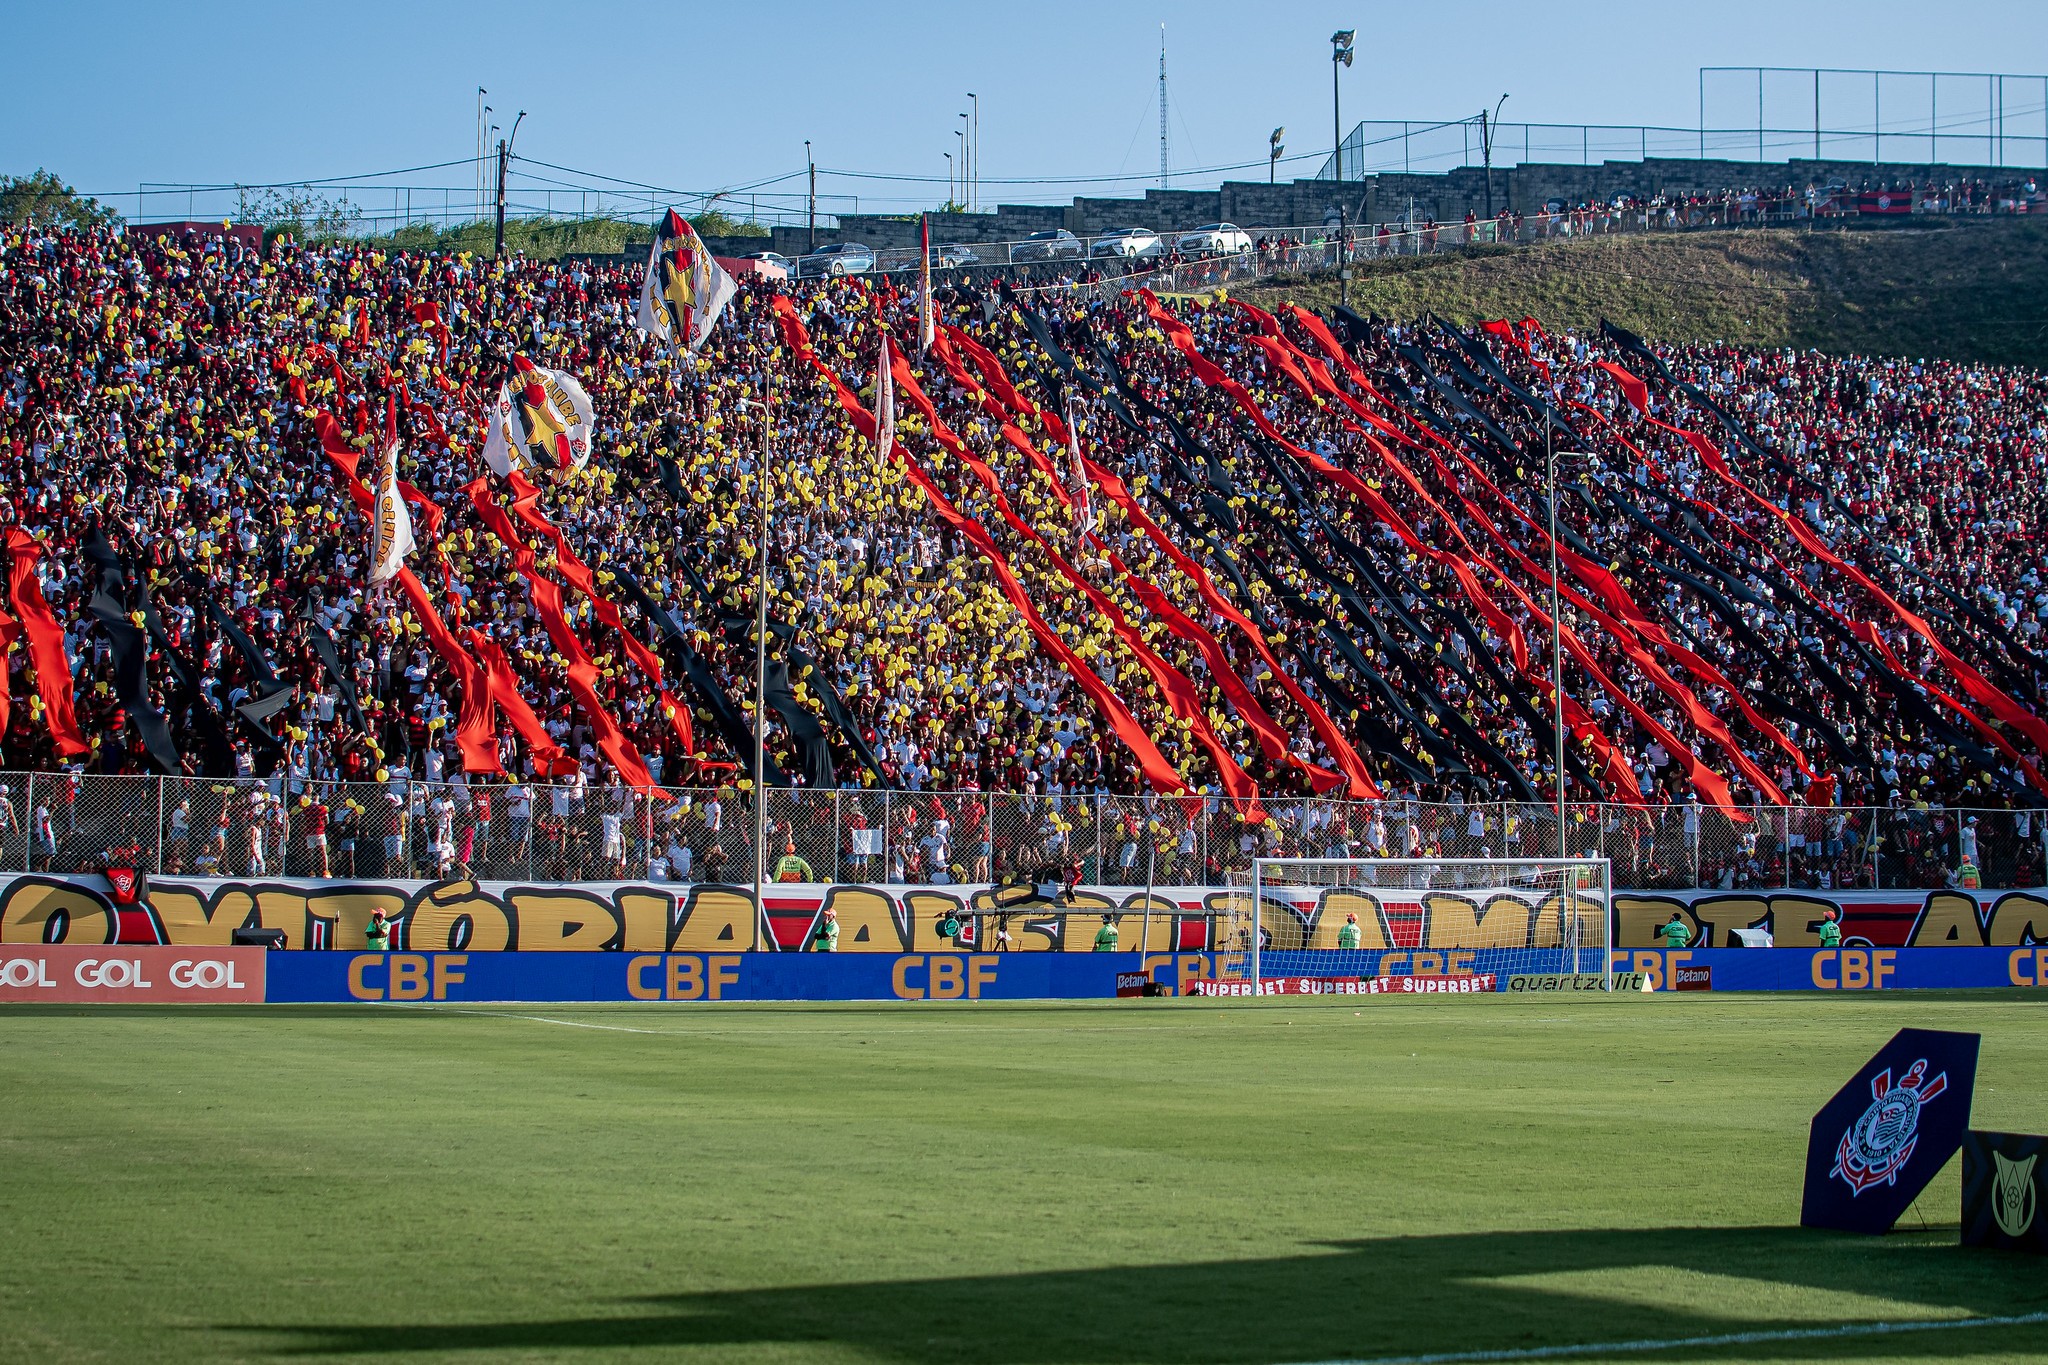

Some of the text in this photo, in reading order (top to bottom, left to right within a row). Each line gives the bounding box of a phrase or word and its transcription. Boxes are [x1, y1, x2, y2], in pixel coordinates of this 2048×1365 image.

[74, 959, 151, 988] GOL
[169, 960, 245, 989] GOL
[347, 954, 468, 1000] CBF
[627, 955, 742, 1000] CBF
[892, 955, 999, 999] CBF
[1116, 974, 1148, 989] Betano
[1510, 972, 1642, 992] quartzolit
[1676, 968, 1709, 983] Betano
[1811, 949, 1897, 989] CBF
[1299, 977, 1389, 995] SUPERBET
[1403, 975, 1490, 993] SUPERBET
